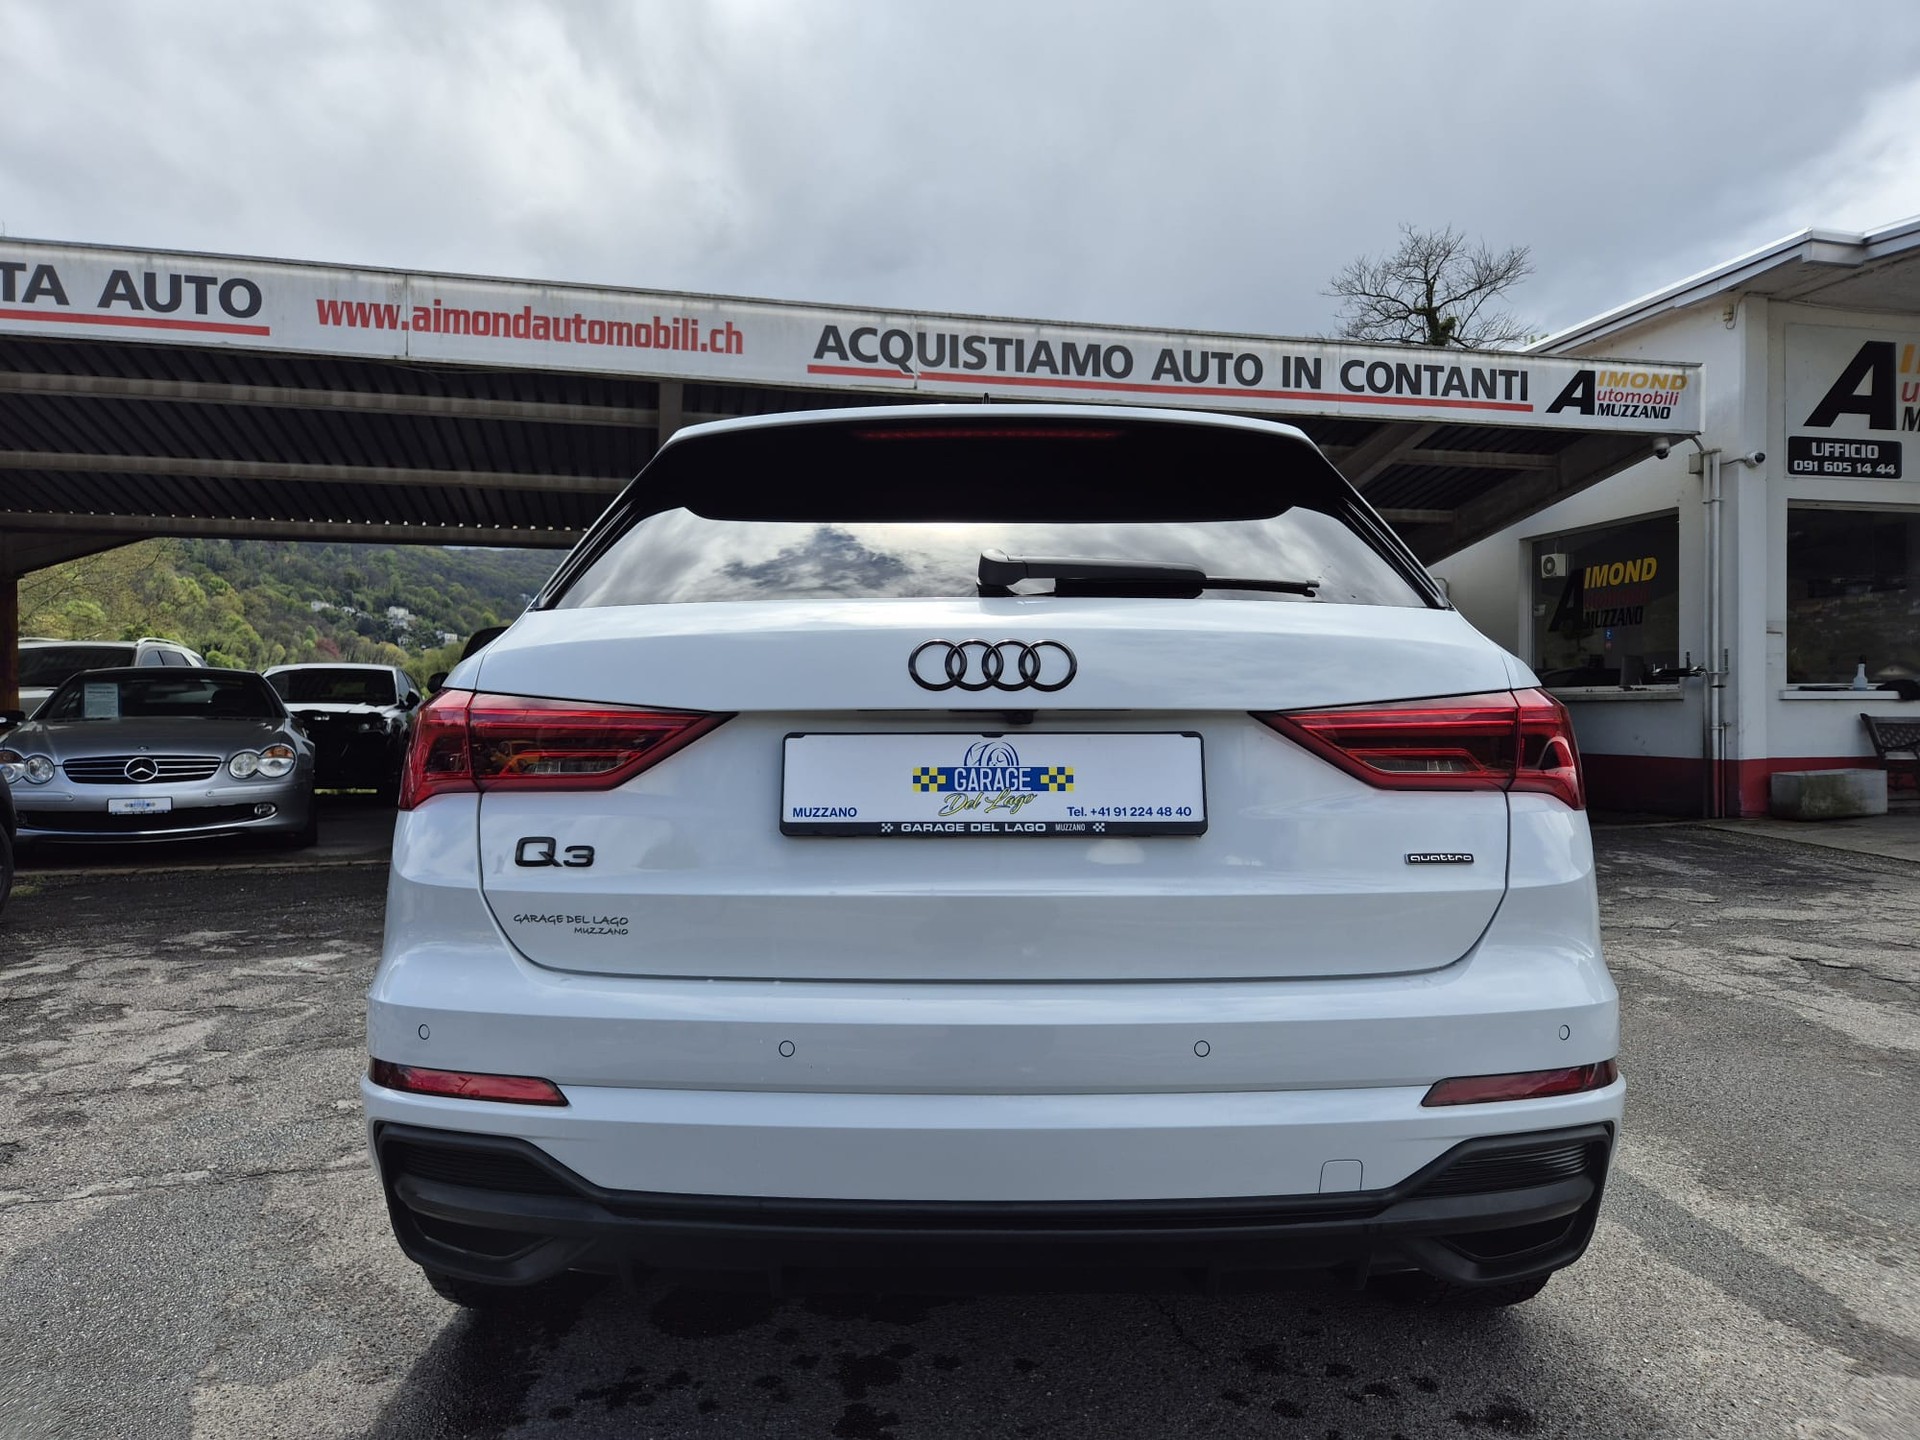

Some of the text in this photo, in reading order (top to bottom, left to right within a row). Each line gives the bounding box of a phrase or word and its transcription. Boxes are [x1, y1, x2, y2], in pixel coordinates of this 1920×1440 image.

[97, 269, 262, 319] AUTO
[316, 298, 744, 355] www.aimondautomobili.ch
[813, 324, 1529, 402] ACQUISTIAMO AUTO IN CONTANTI
[1597, 403, 1671, 420] MUZZANO
[1811, 441, 1880, 459] UFFICIO
[1793, 460, 1896, 475] 091 605 14 44
[1583, 557, 1658, 589] IMOND
[954, 767, 1032, 791] GARAGE
[938, 788, 1038, 817] Del Lago
[792, 807, 858, 818] MUZZANO
[1067, 806, 1192, 817] Tel. +41 91 224 48 40
[901, 823, 1086, 832] GARAGE DEL LAGO MUZZANO
[515, 836, 595, 868] Q3
[1410, 854, 1472, 863] quattro
[513, 914, 629, 926] GARAGE DEL LAGO
[574, 927, 629, 935] MUZZANO
